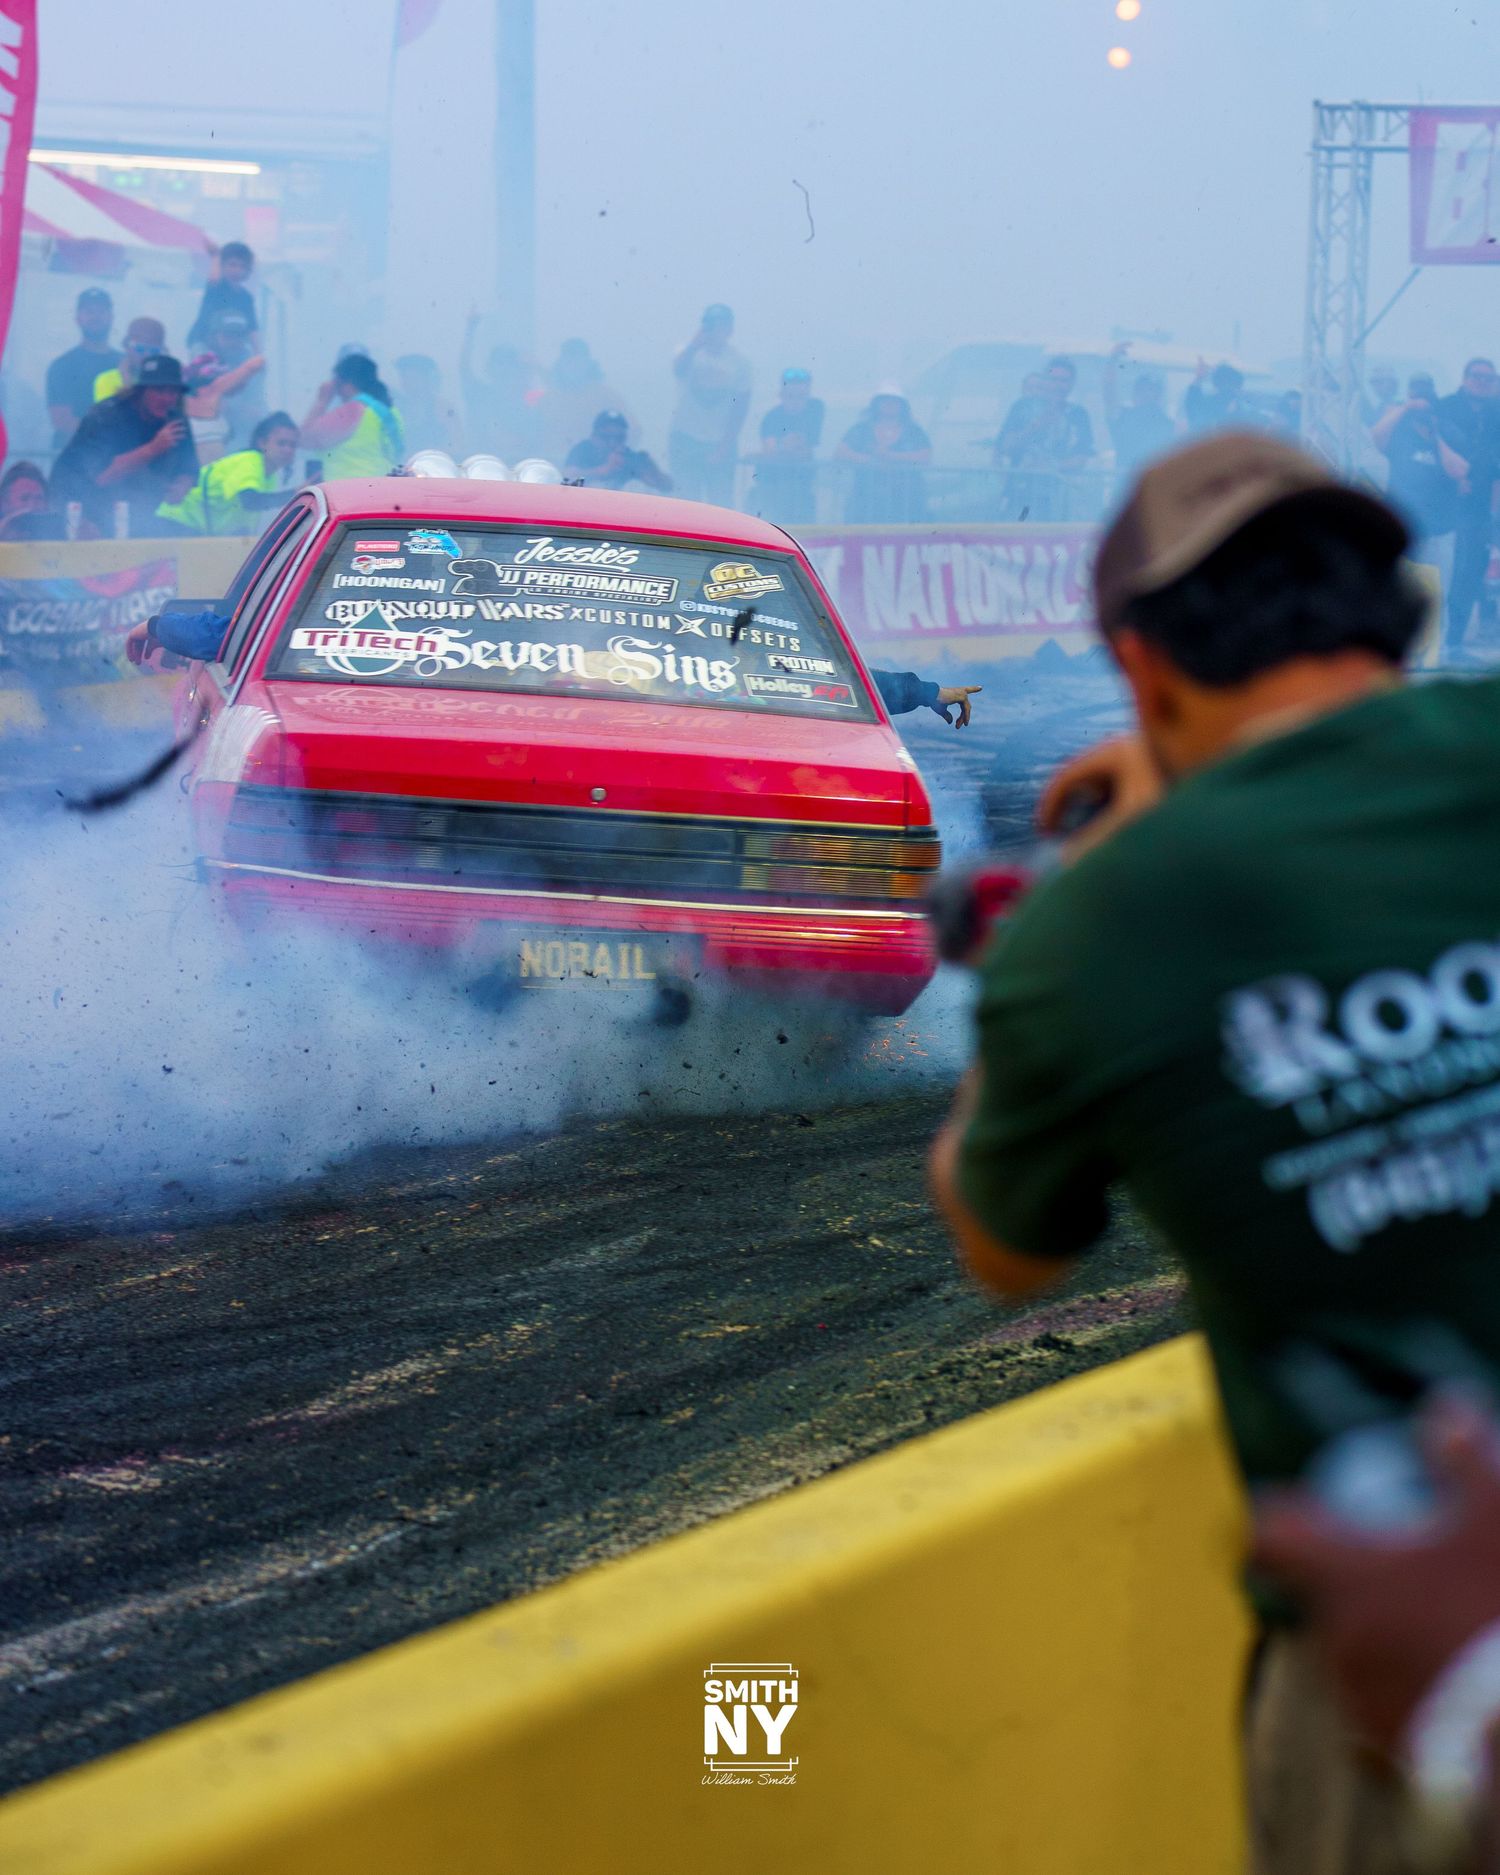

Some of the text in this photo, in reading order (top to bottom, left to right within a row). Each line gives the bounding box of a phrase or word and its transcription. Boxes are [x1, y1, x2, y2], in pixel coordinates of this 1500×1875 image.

[500, 568, 670, 597] JJ PERFORMANCE
[303, 629, 438, 653] TriTech
[585, 605, 671, 630] CUSTOM
[710, 622, 801, 652] OFFSETS
[413, 626, 740, 692] Seven Sins
[750, 676, 814, 699] Holley
